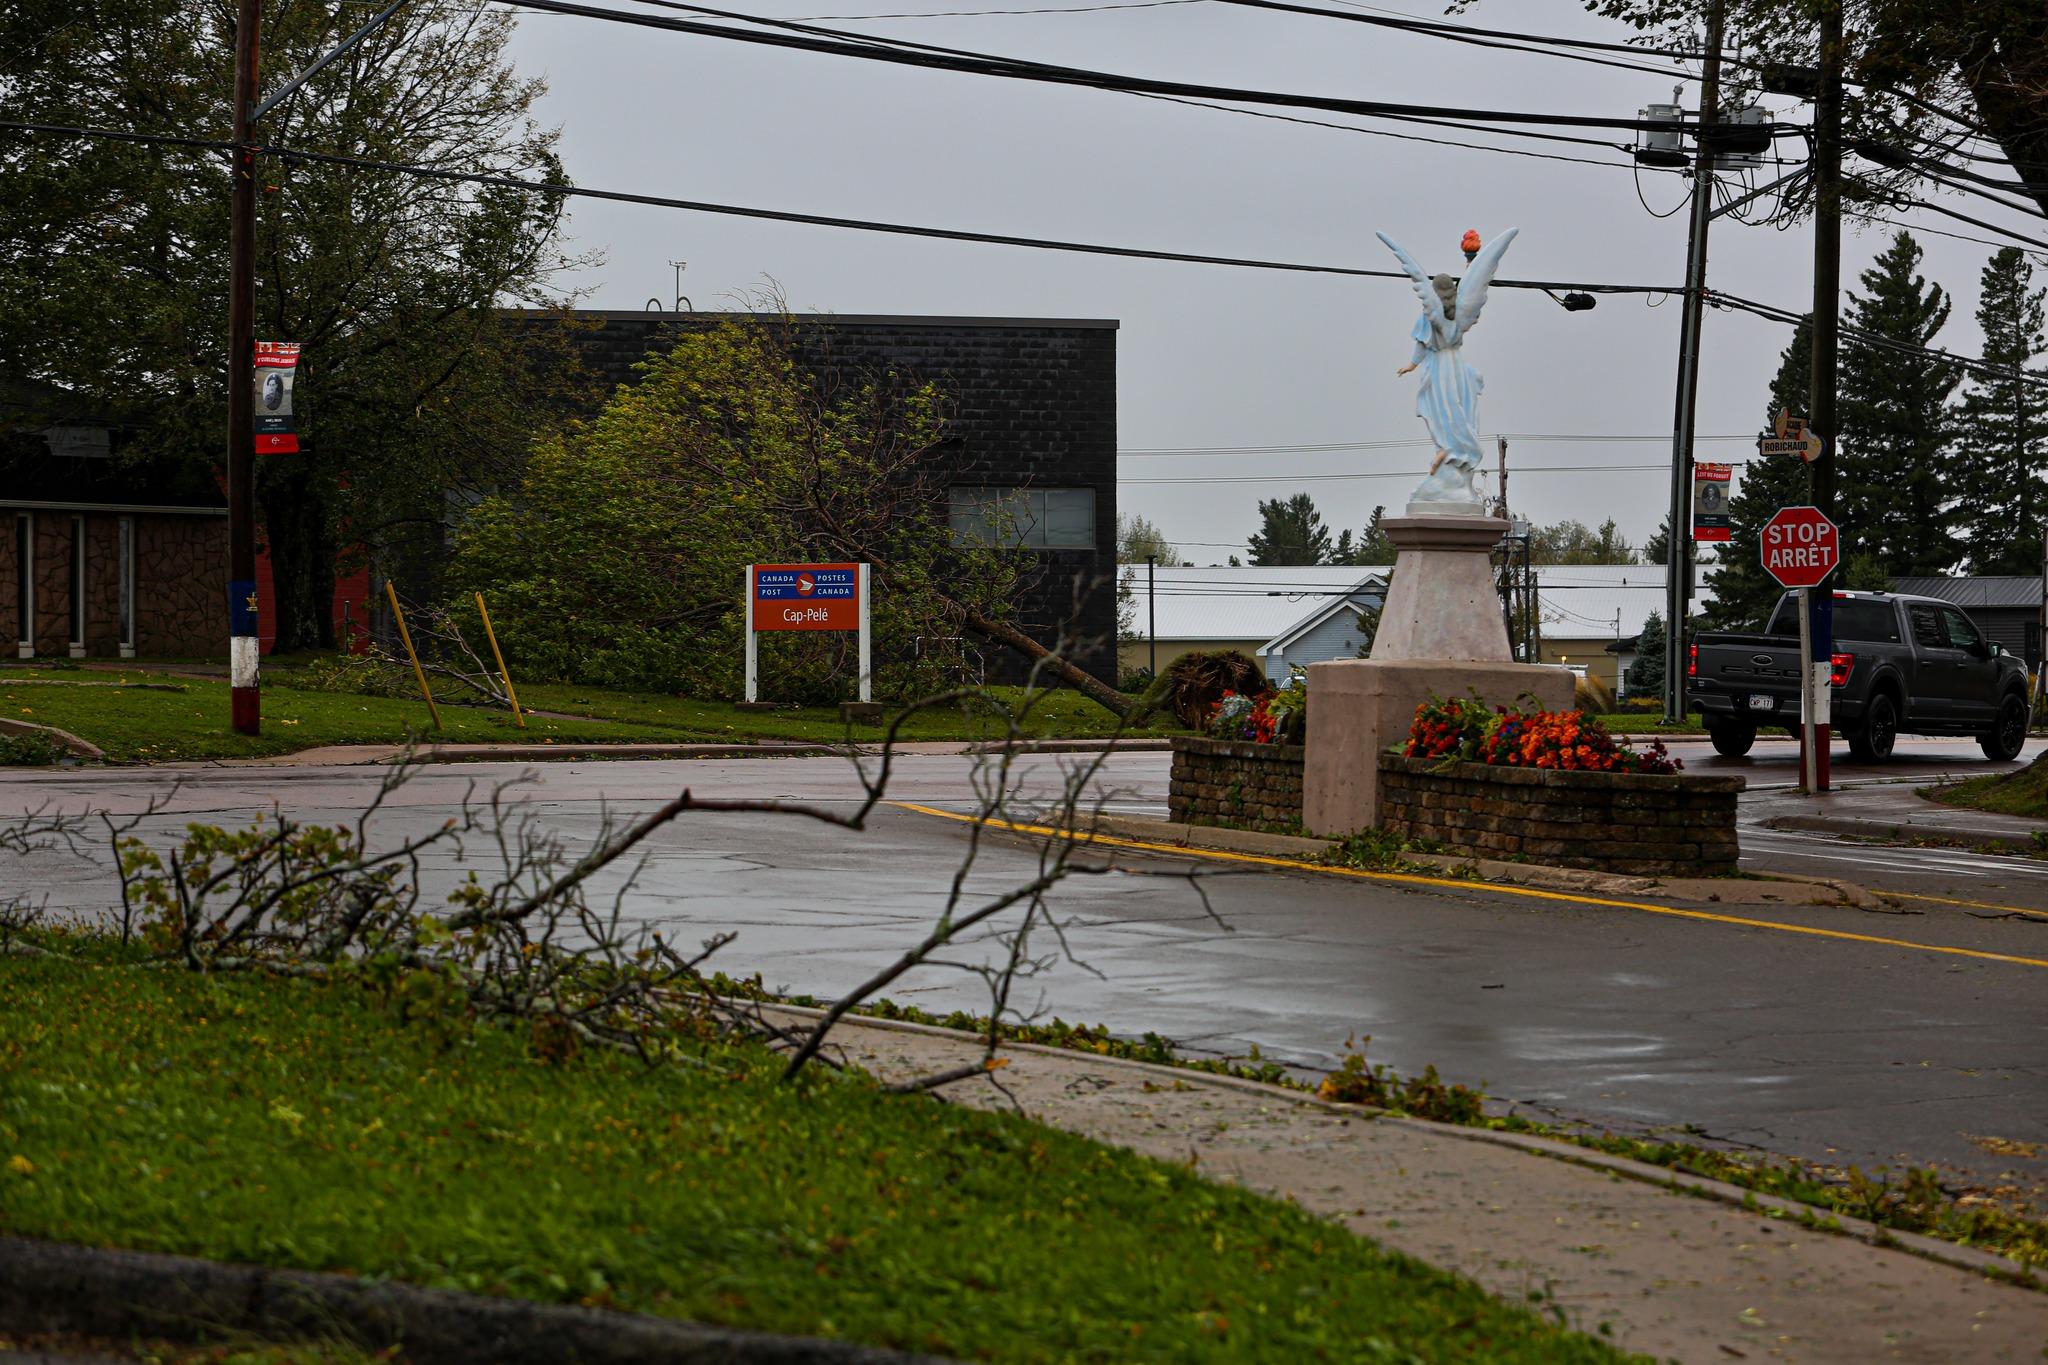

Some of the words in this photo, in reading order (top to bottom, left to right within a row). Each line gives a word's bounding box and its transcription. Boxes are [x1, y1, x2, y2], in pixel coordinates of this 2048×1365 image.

[1764, 441, 1808, 452] ROBICHAUD
[1768, 522, 1831, 545] STOP
[1769, 542, 1832, 568] ARRÊT
[761, 588, 781, 596] POST
[783, 607, 829, 625] Cap-Pelé
